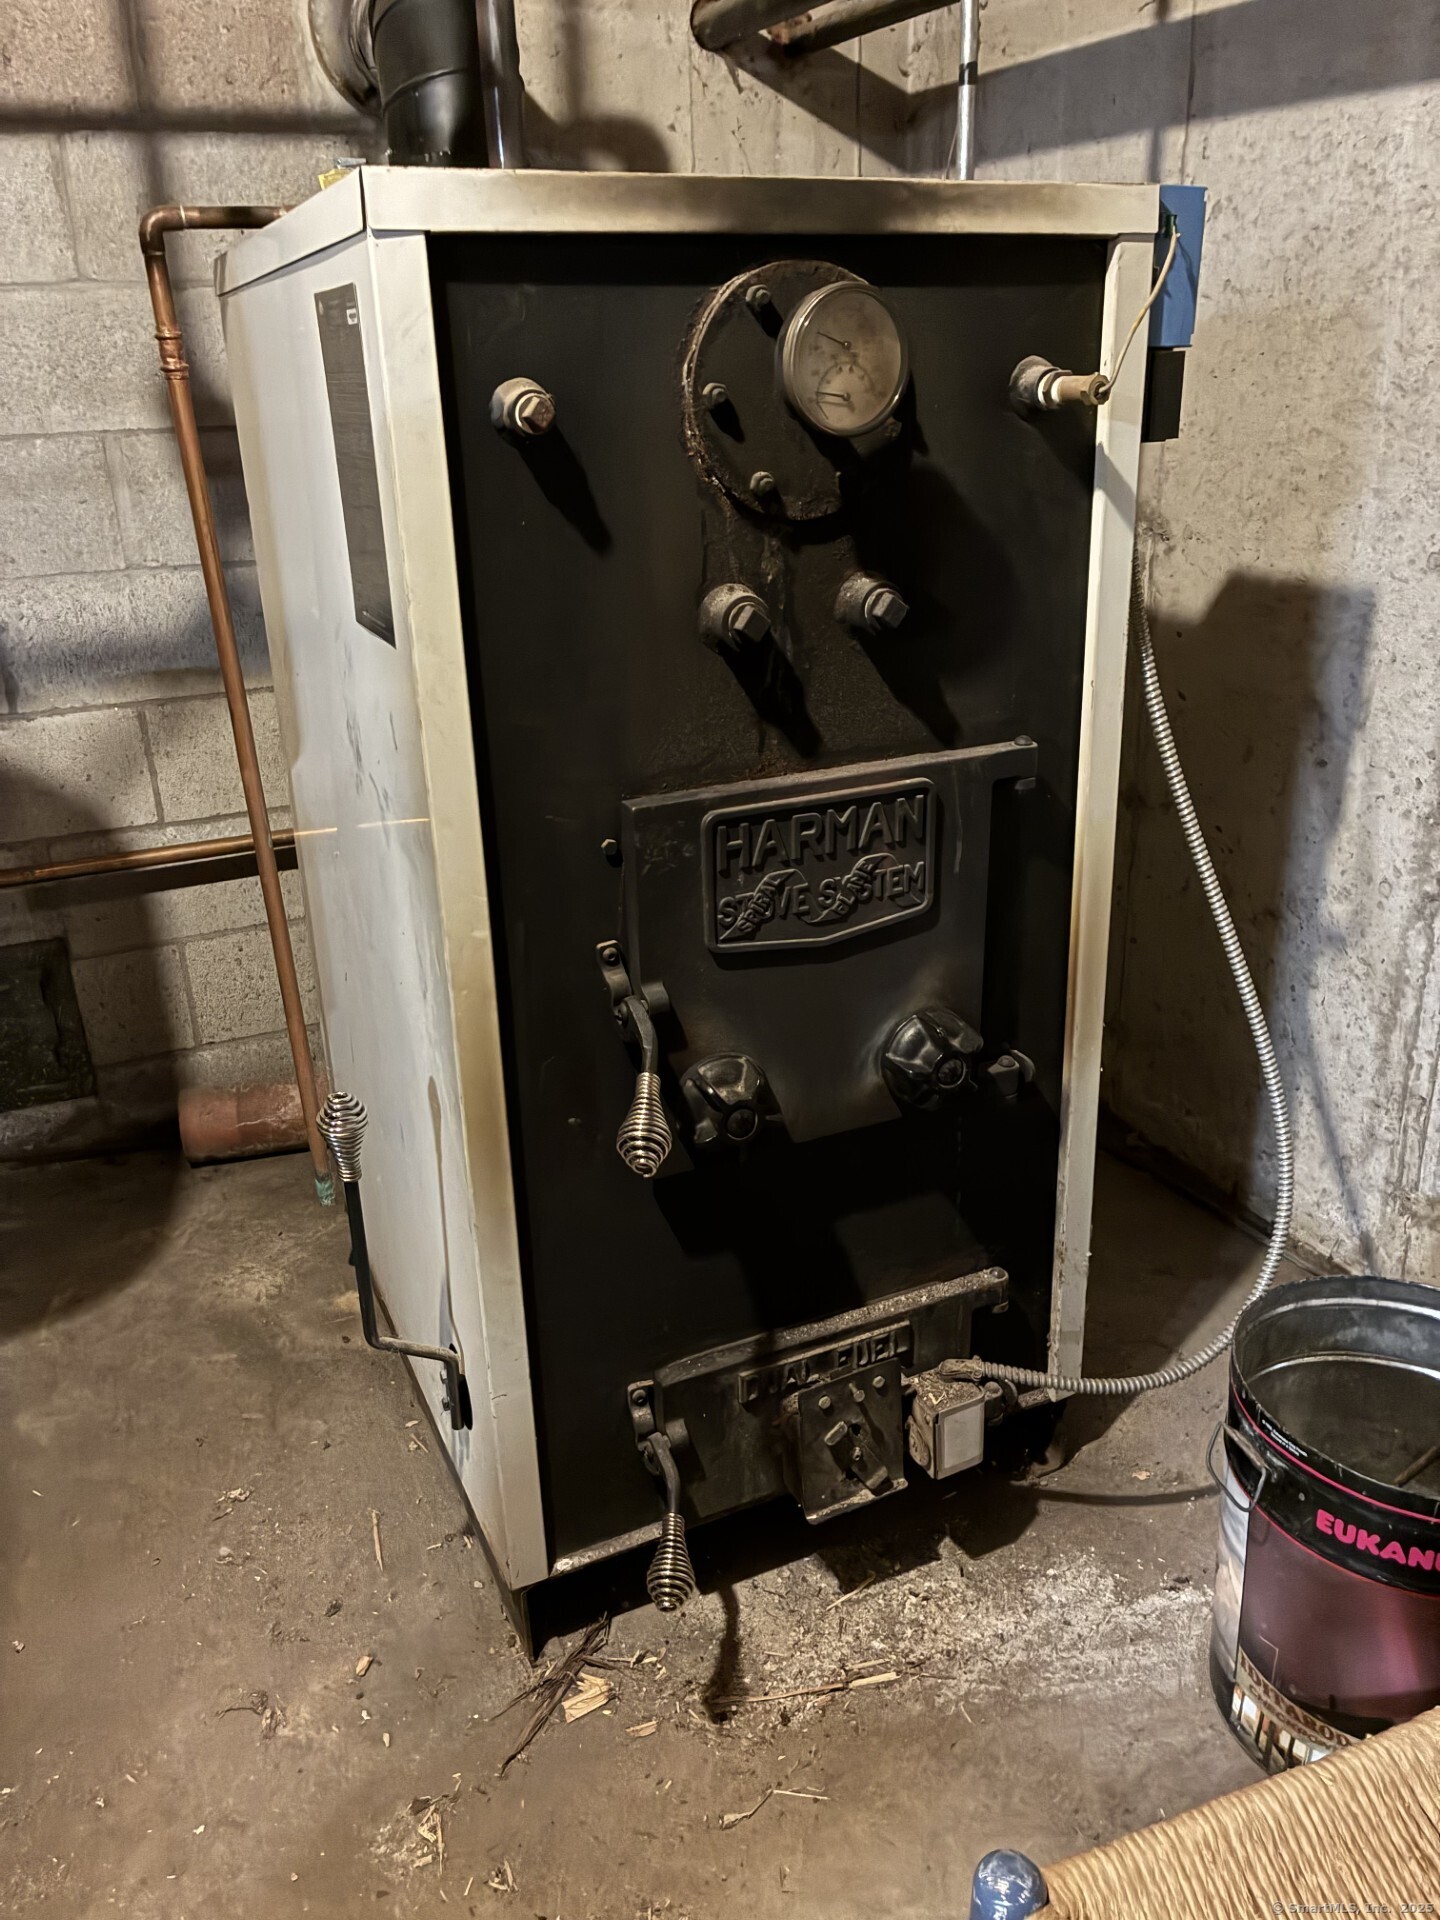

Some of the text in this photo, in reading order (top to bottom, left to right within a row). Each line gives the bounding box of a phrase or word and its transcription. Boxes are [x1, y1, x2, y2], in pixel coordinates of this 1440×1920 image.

[716, 795, 925, 874] HARMAN
[837, 1333, 909, 1368] FUEL
[1316, 1509, 1440, 1571] EUKAN
